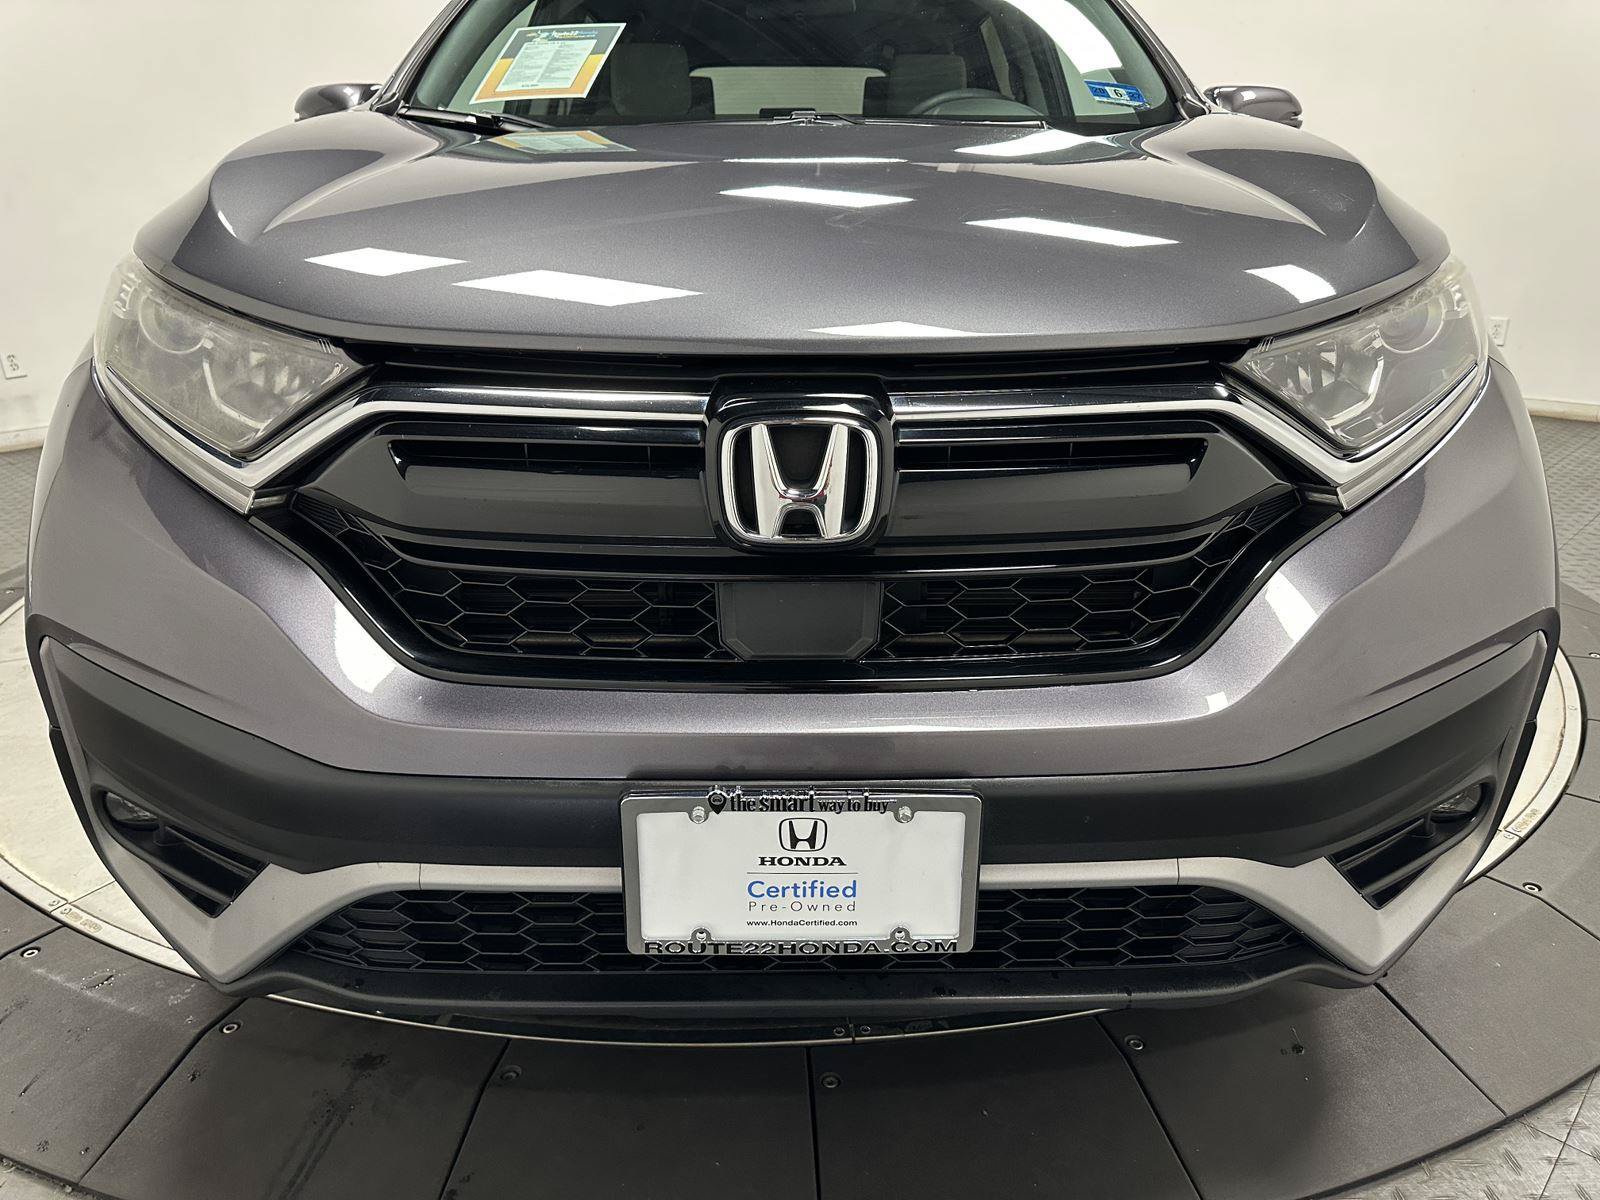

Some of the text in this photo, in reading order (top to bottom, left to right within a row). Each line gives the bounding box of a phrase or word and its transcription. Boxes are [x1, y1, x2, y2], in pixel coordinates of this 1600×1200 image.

[1114, 89, 1123, 98] 6
[731, 793, 889, 815] the smart way to buy
[758, 856, 847, 867] HONDA
[747, 879, 857, 898] Certified
[748, 900, 856, 912] Pre-Owned
[746, 919, 858, 927] www.HondaCertified.com
[644, 940, 958, 955] ROUTE22HONDA.COM
